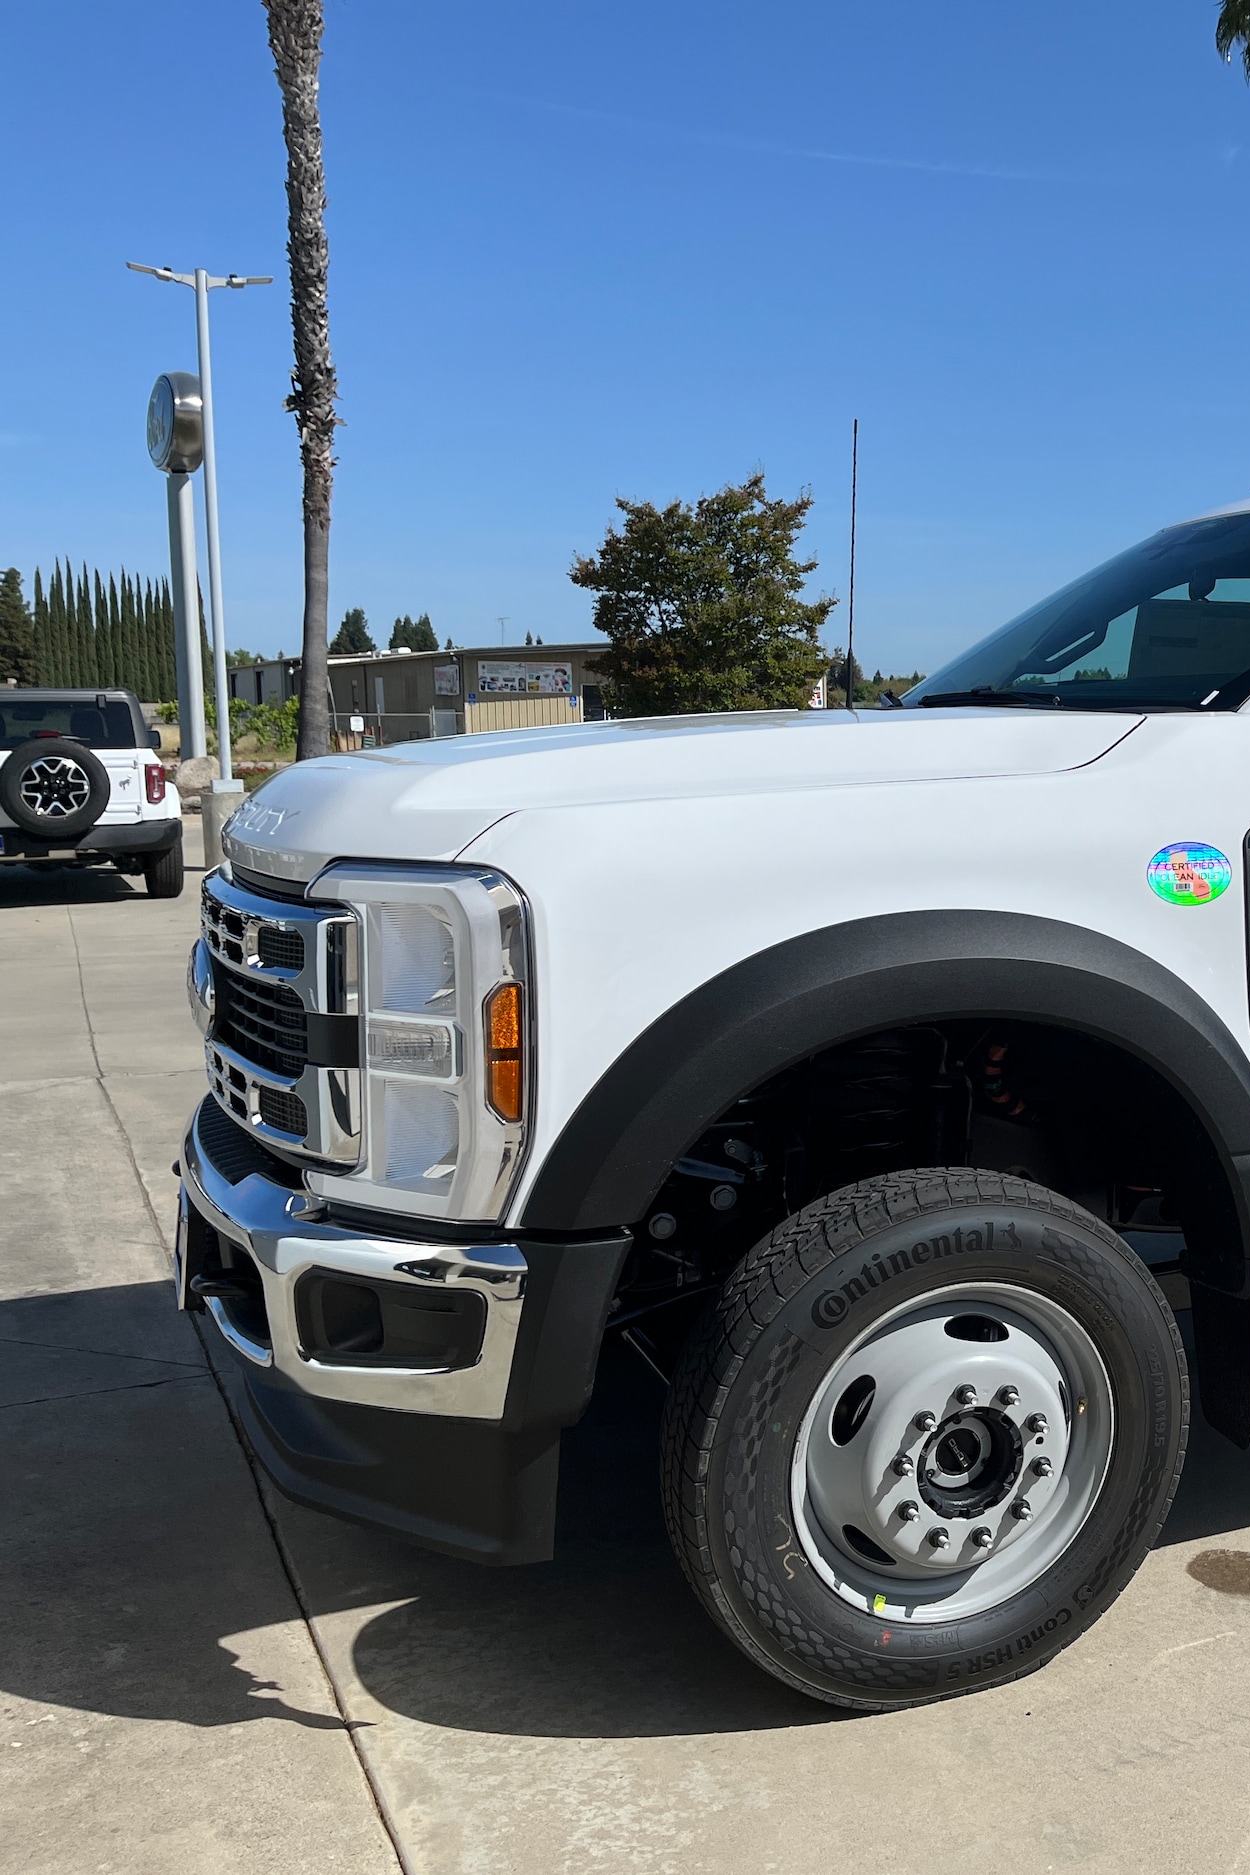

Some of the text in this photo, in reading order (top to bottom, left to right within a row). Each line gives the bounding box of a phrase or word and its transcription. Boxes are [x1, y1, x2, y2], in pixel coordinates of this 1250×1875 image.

[1160, 871, 1220, 882] CLEAN IDLE
[1164, 861, 1215, 871] CERTIFIED
[811, 1222, 995, 1329] Continental
[1016, 1607, 1072, 1655] Conti
